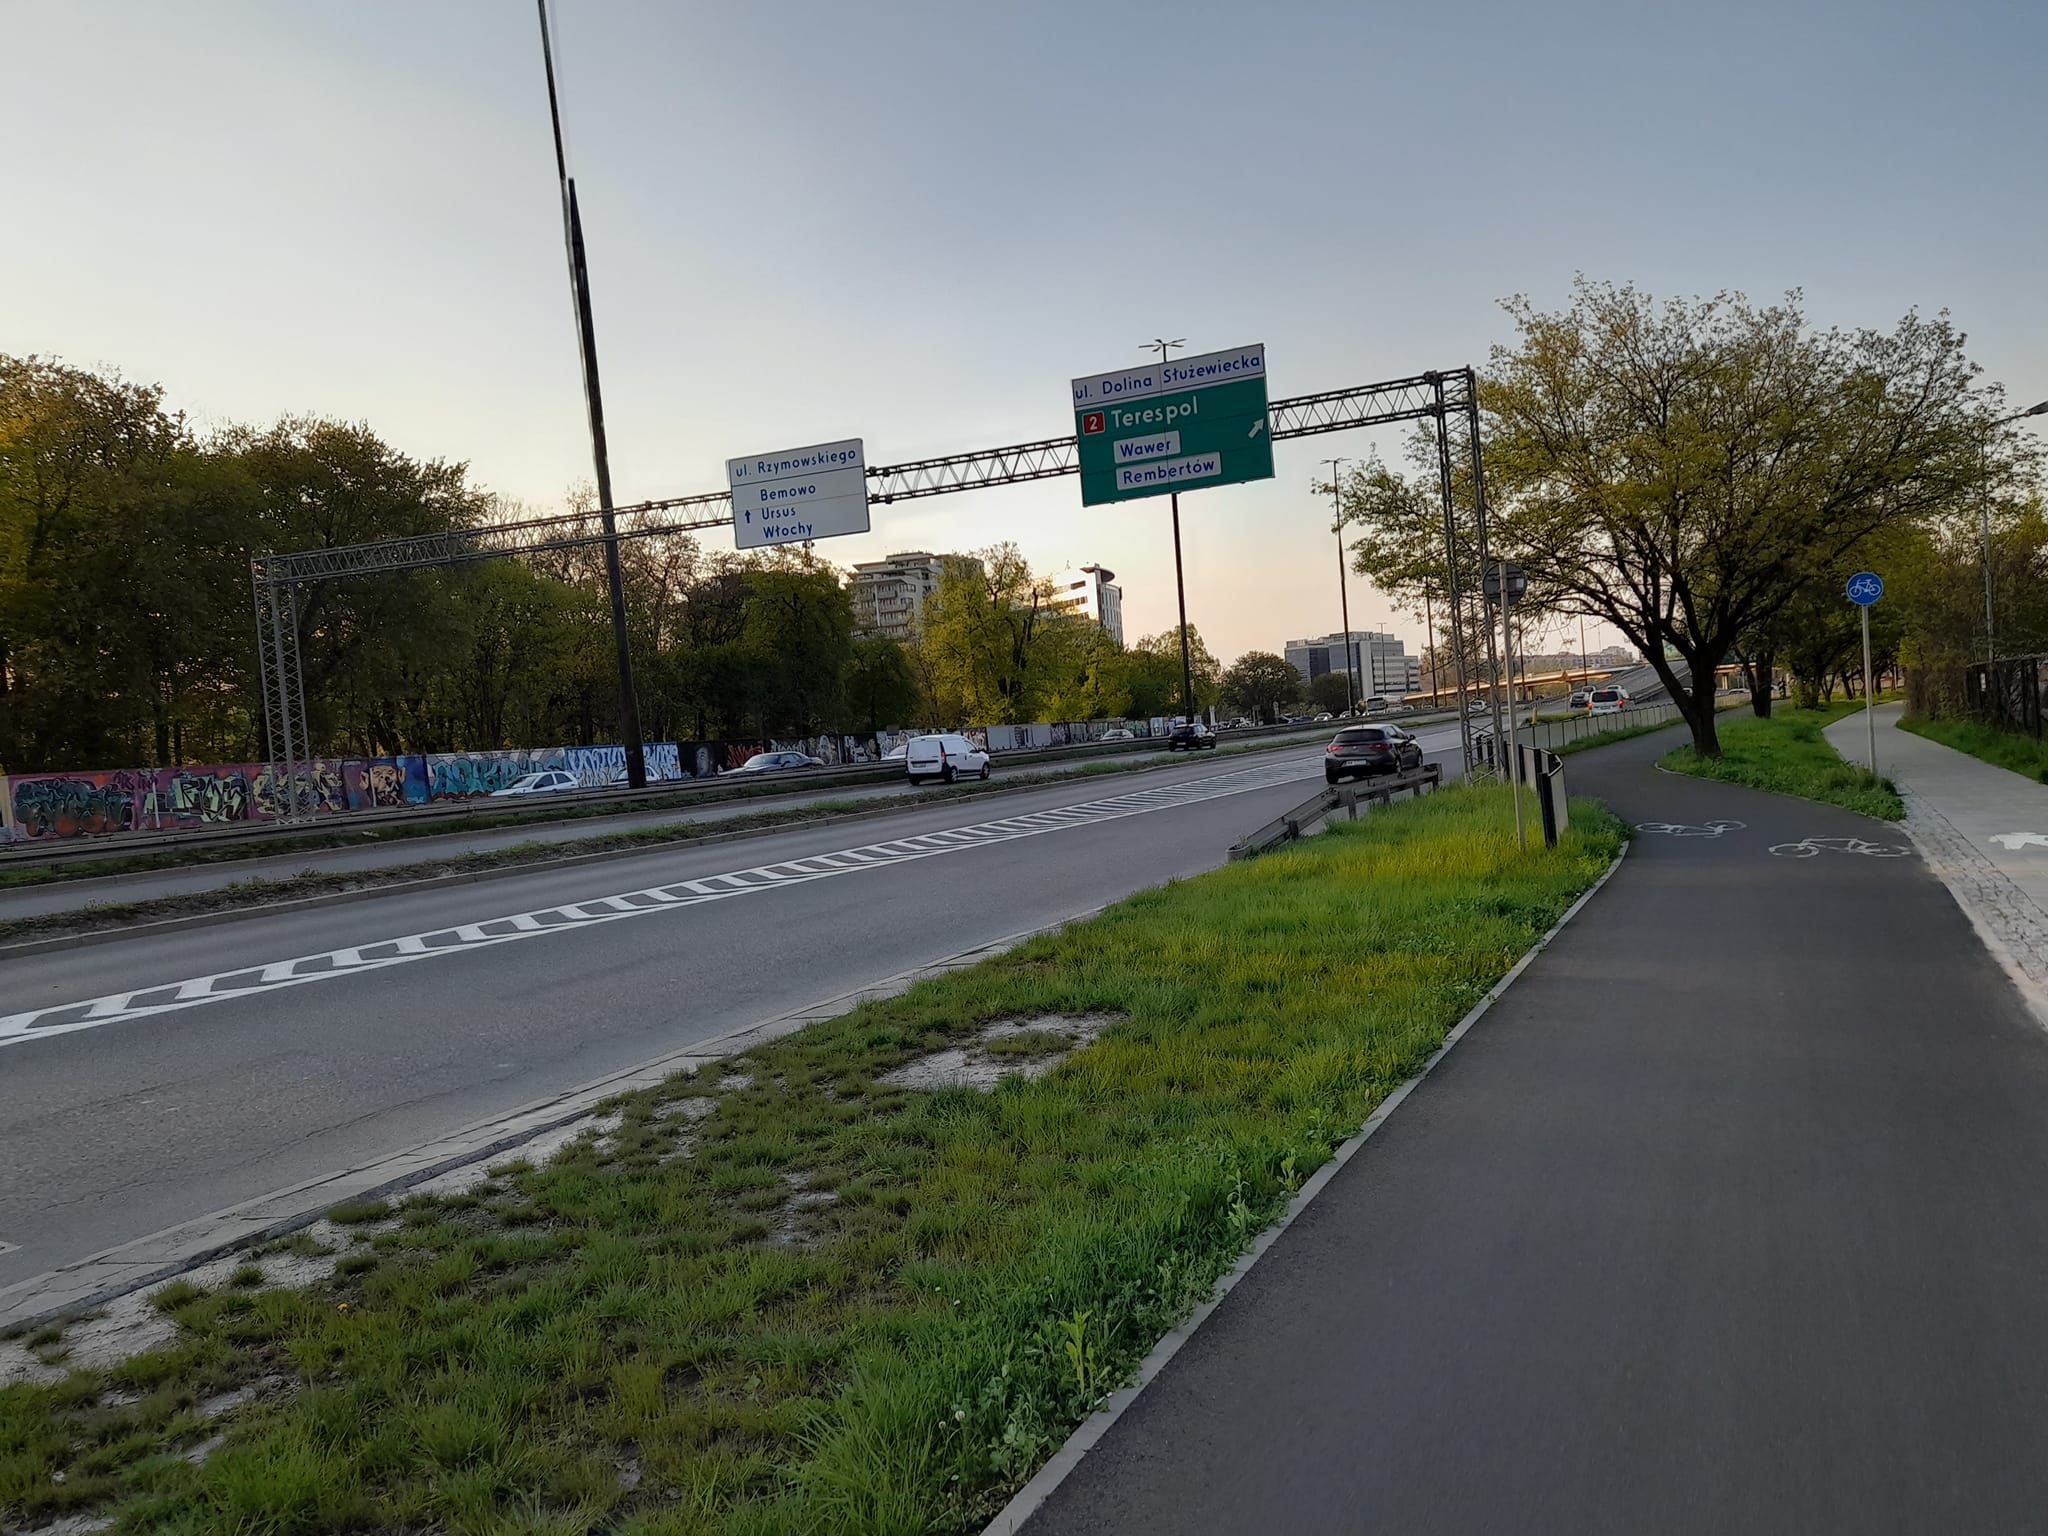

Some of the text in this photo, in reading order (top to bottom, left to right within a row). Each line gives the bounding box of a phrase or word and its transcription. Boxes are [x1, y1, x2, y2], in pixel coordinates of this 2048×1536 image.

[1075, 354, 1260, 399] ul. Dolina Służewiecka
[1089, 395, 1198, 430] 2 Terespol
[1119, 438, 1171, 457] Wawer
[736, 449, 856, 477] ul. Rzymowskiego
[1123, 458, 1214, 485] Rembertów
[760, 484, 816, 501] Bemowo
[761, 506, 796, 520] Ursus
[763, 522, 813, 539] Włochy
